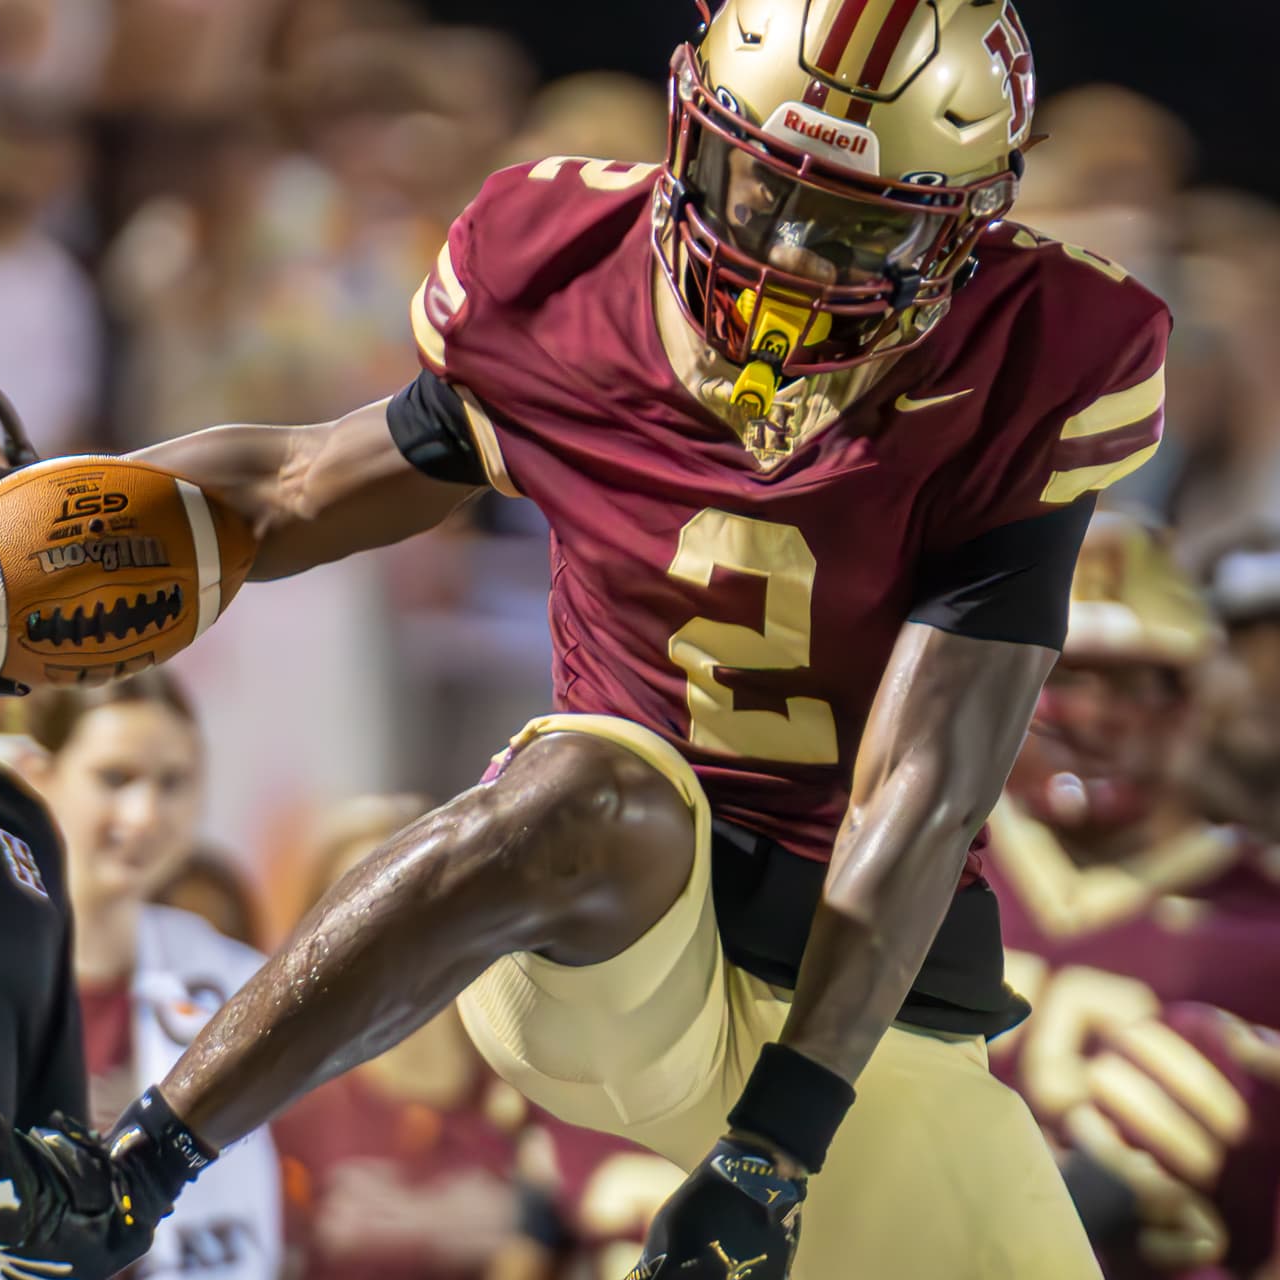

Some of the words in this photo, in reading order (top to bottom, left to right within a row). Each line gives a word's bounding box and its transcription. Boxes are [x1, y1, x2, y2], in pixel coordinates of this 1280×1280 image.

[783, 109, 870, 155] Riddell
[55, 494, 129, 524] GST
[668, 507, 838, 764] 2
